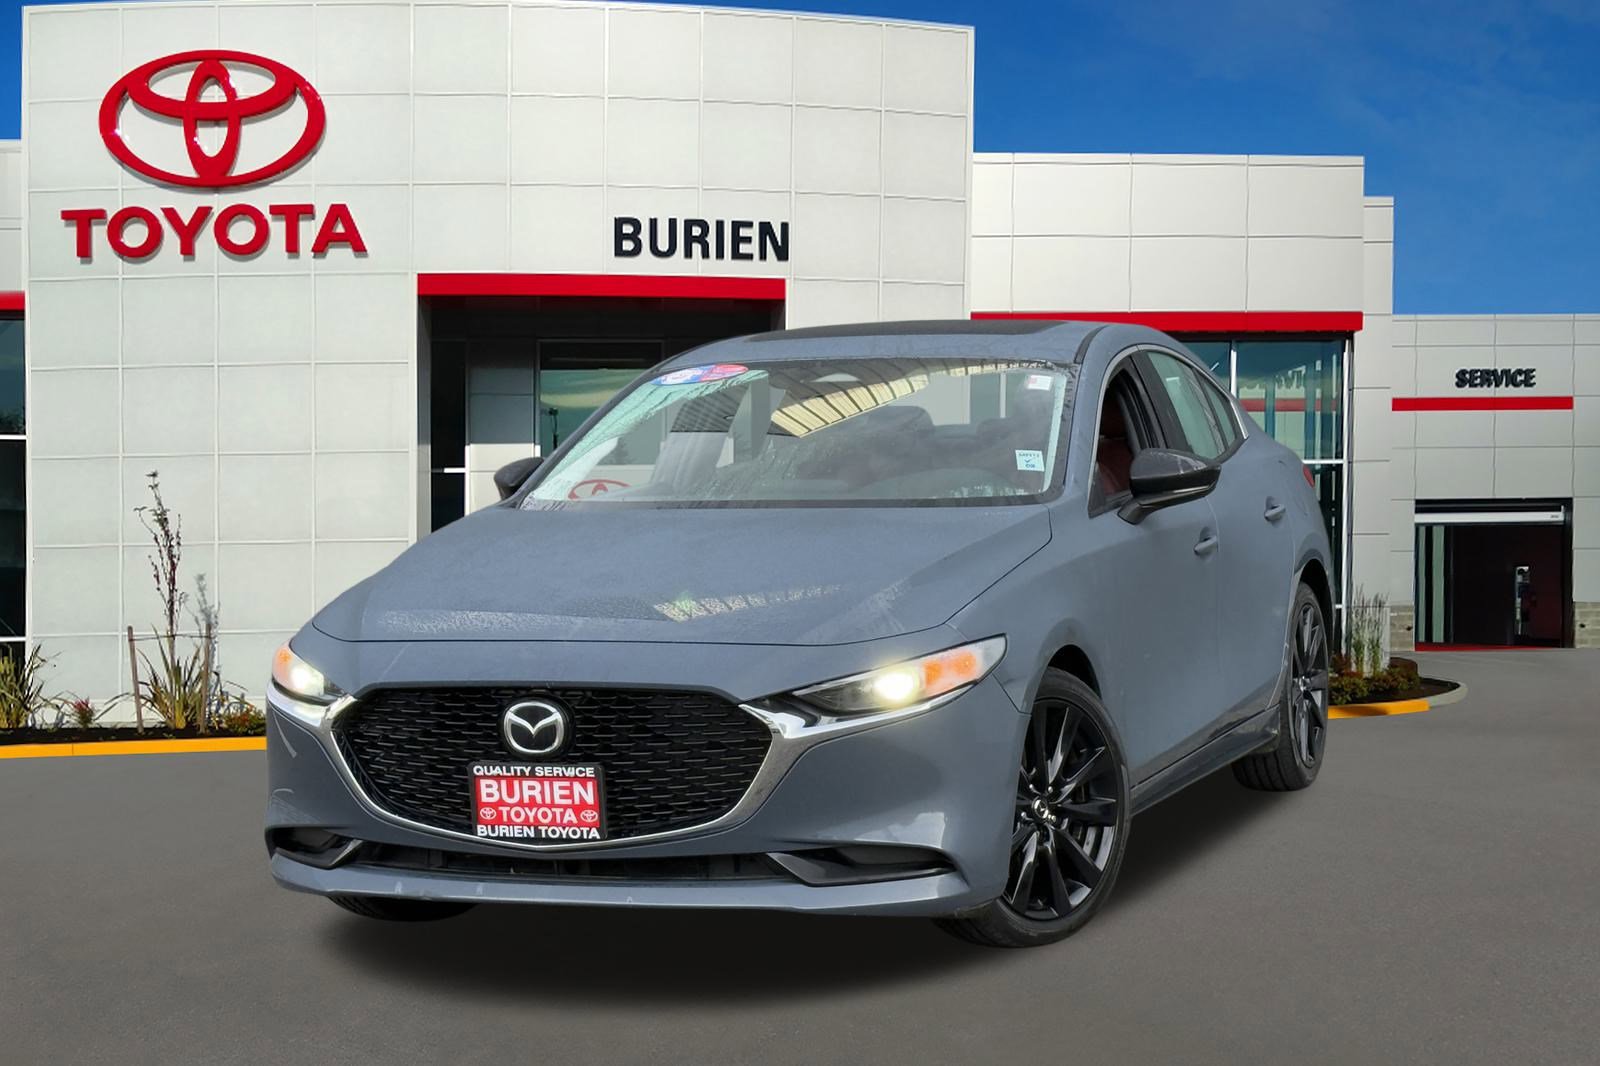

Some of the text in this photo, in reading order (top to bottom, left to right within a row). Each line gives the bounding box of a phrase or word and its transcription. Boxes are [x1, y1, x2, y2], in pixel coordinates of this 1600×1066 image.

[61, 203, 367, 260] TOYOTA
[614, 217, 789, 261] BURIEN
[1455, 368, 1536, 388] SERVICE
[473, 765, 595, 778] QUALITY SERVICE
[480, 779, 595, 805] BURIEN
[498, 806, 578, 824] TOYOTA
[477, 825, 600, 839] BURIEN TOYOTA
